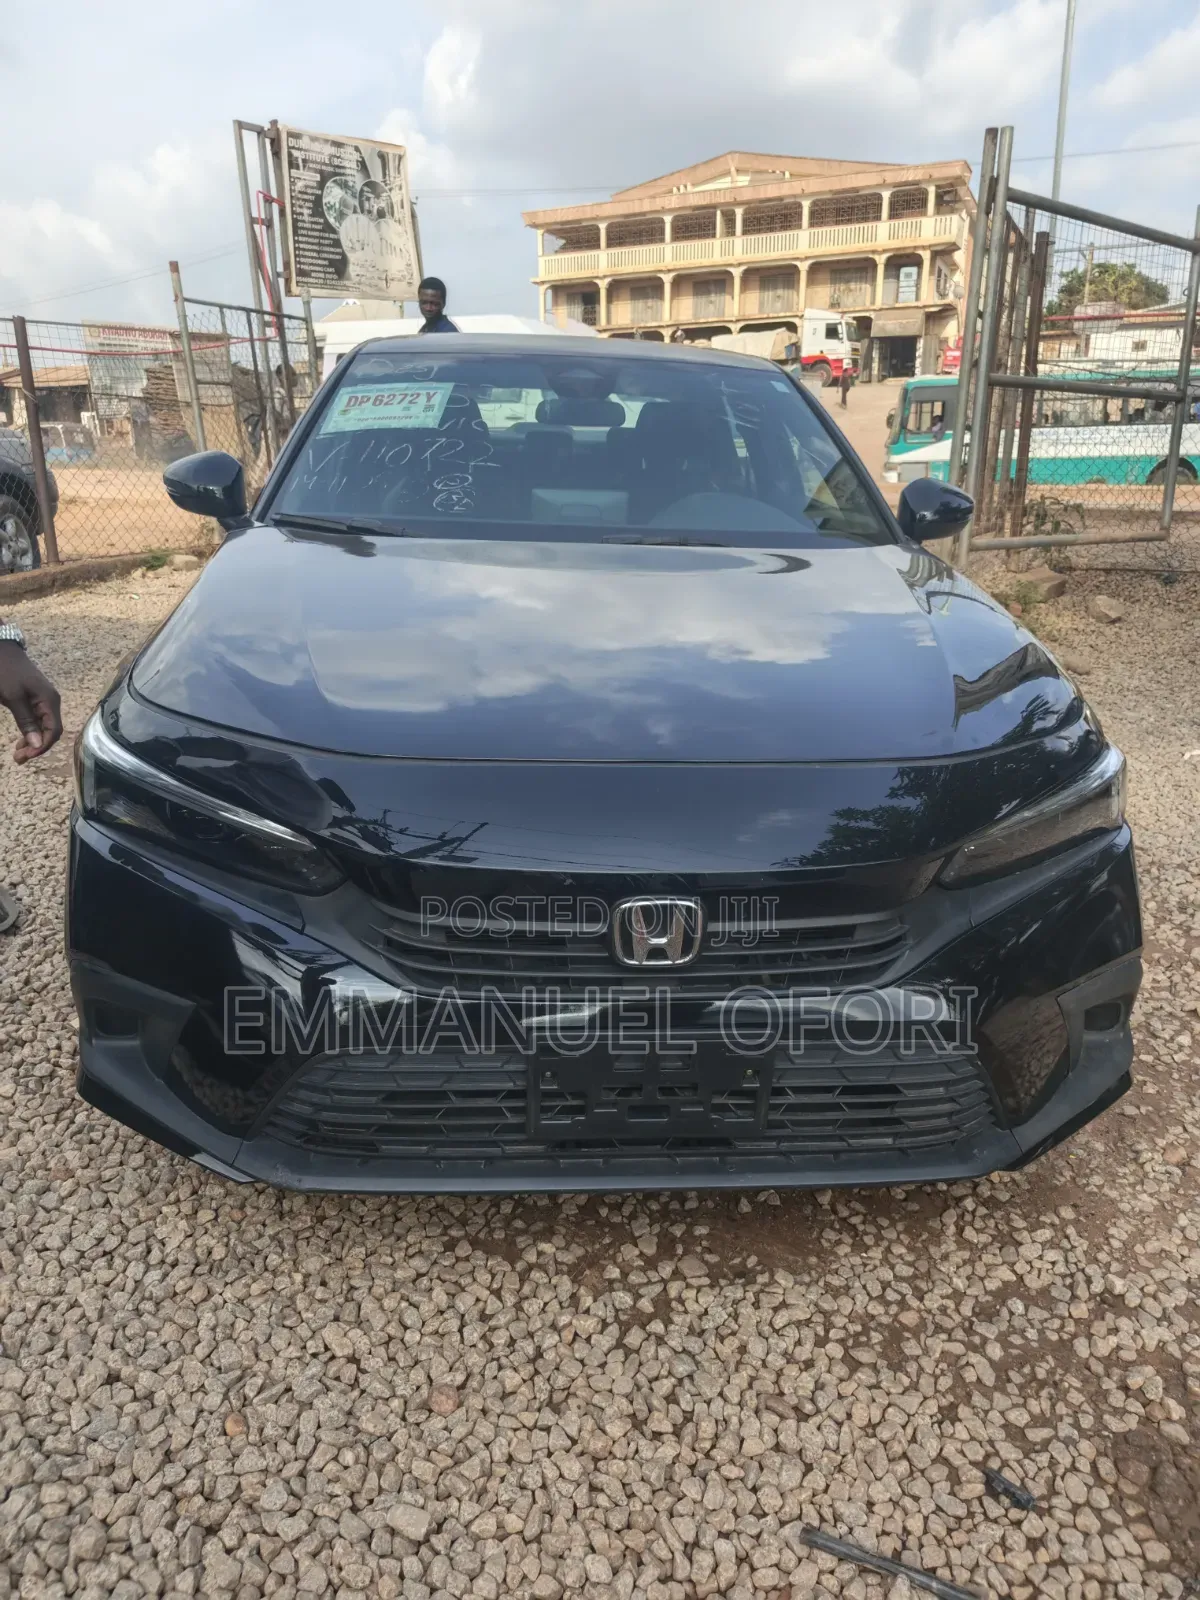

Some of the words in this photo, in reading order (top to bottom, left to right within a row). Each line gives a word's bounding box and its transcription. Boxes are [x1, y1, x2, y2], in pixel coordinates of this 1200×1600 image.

[344, 396, 372, 408] DP
[372, 392, 421, 407] 6272
[424, 391, 439, 404] Y
